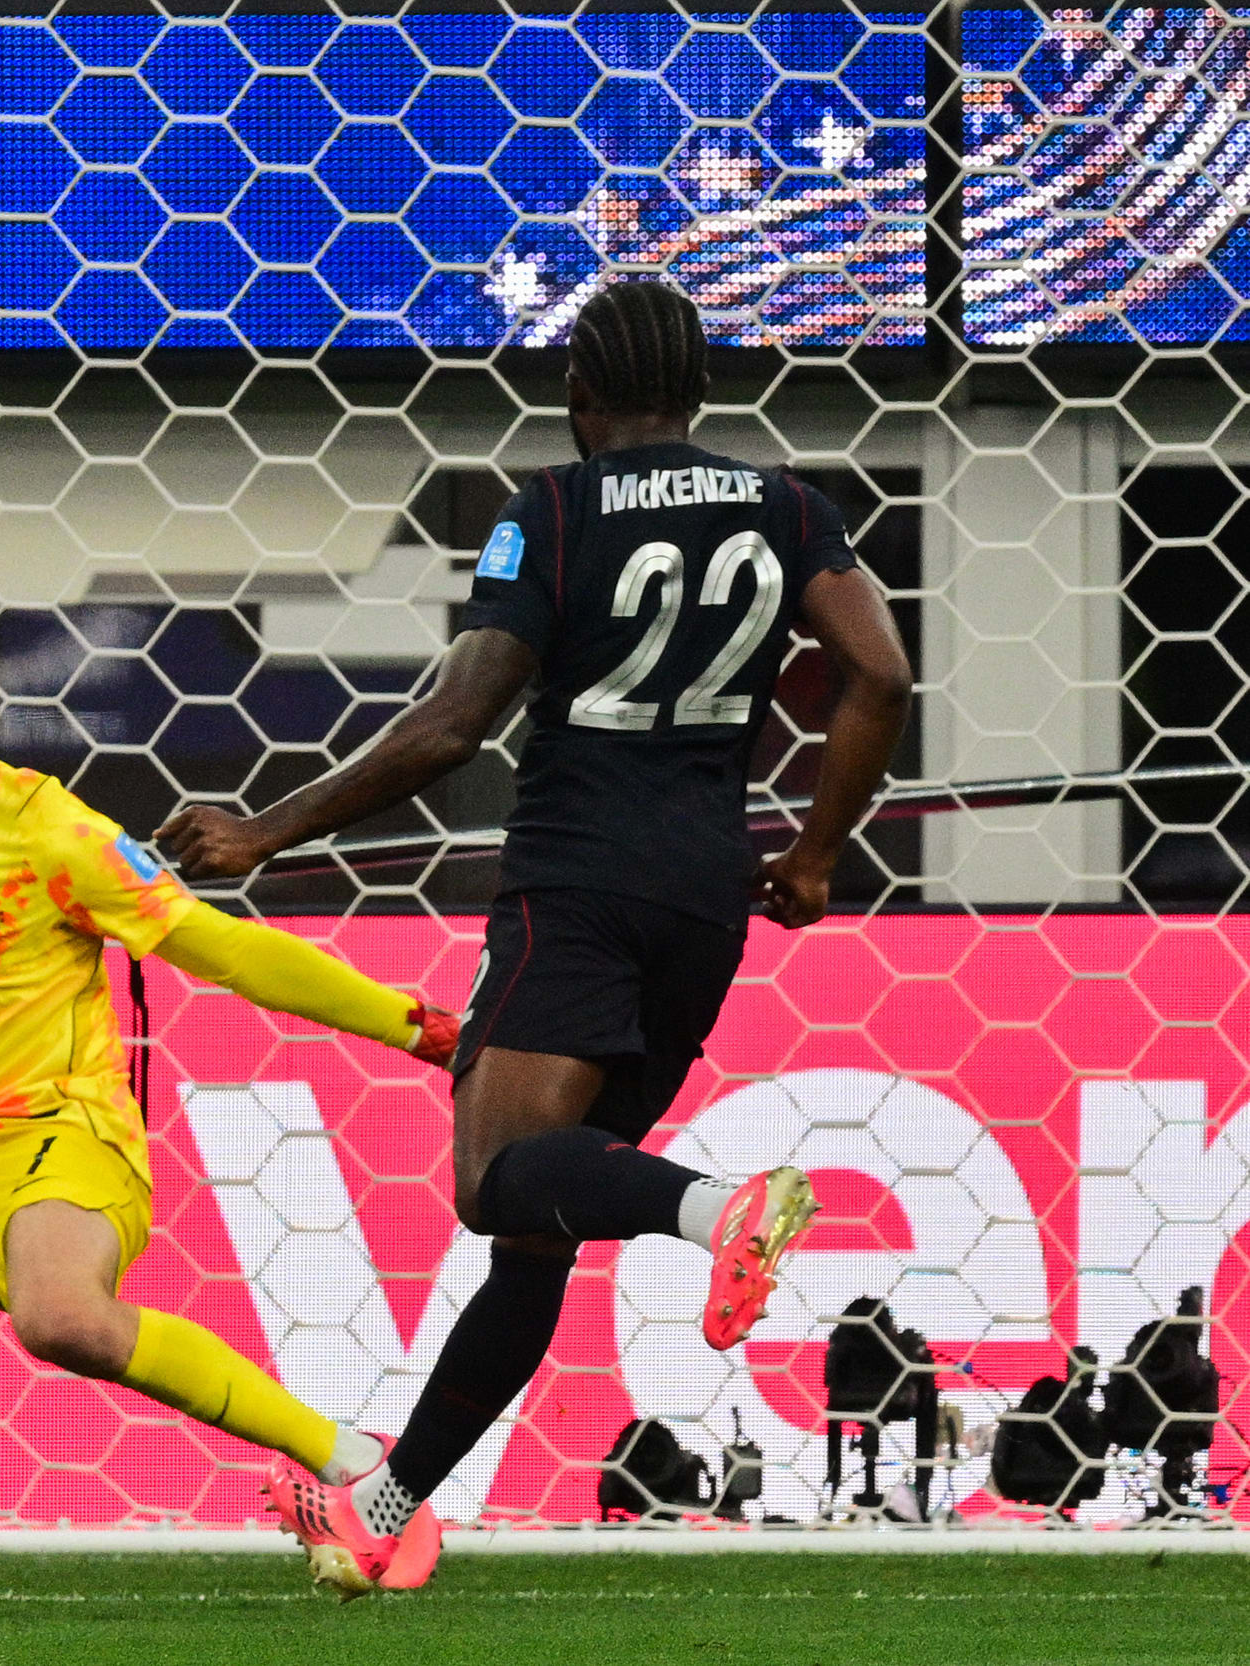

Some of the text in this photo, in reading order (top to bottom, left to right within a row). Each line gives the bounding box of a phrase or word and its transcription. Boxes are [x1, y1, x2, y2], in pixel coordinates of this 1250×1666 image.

[601, 466, 763, 515] McKENZIE
[568, 530, 783, 730] 22
[27, 1136, 57, 1175] 1
